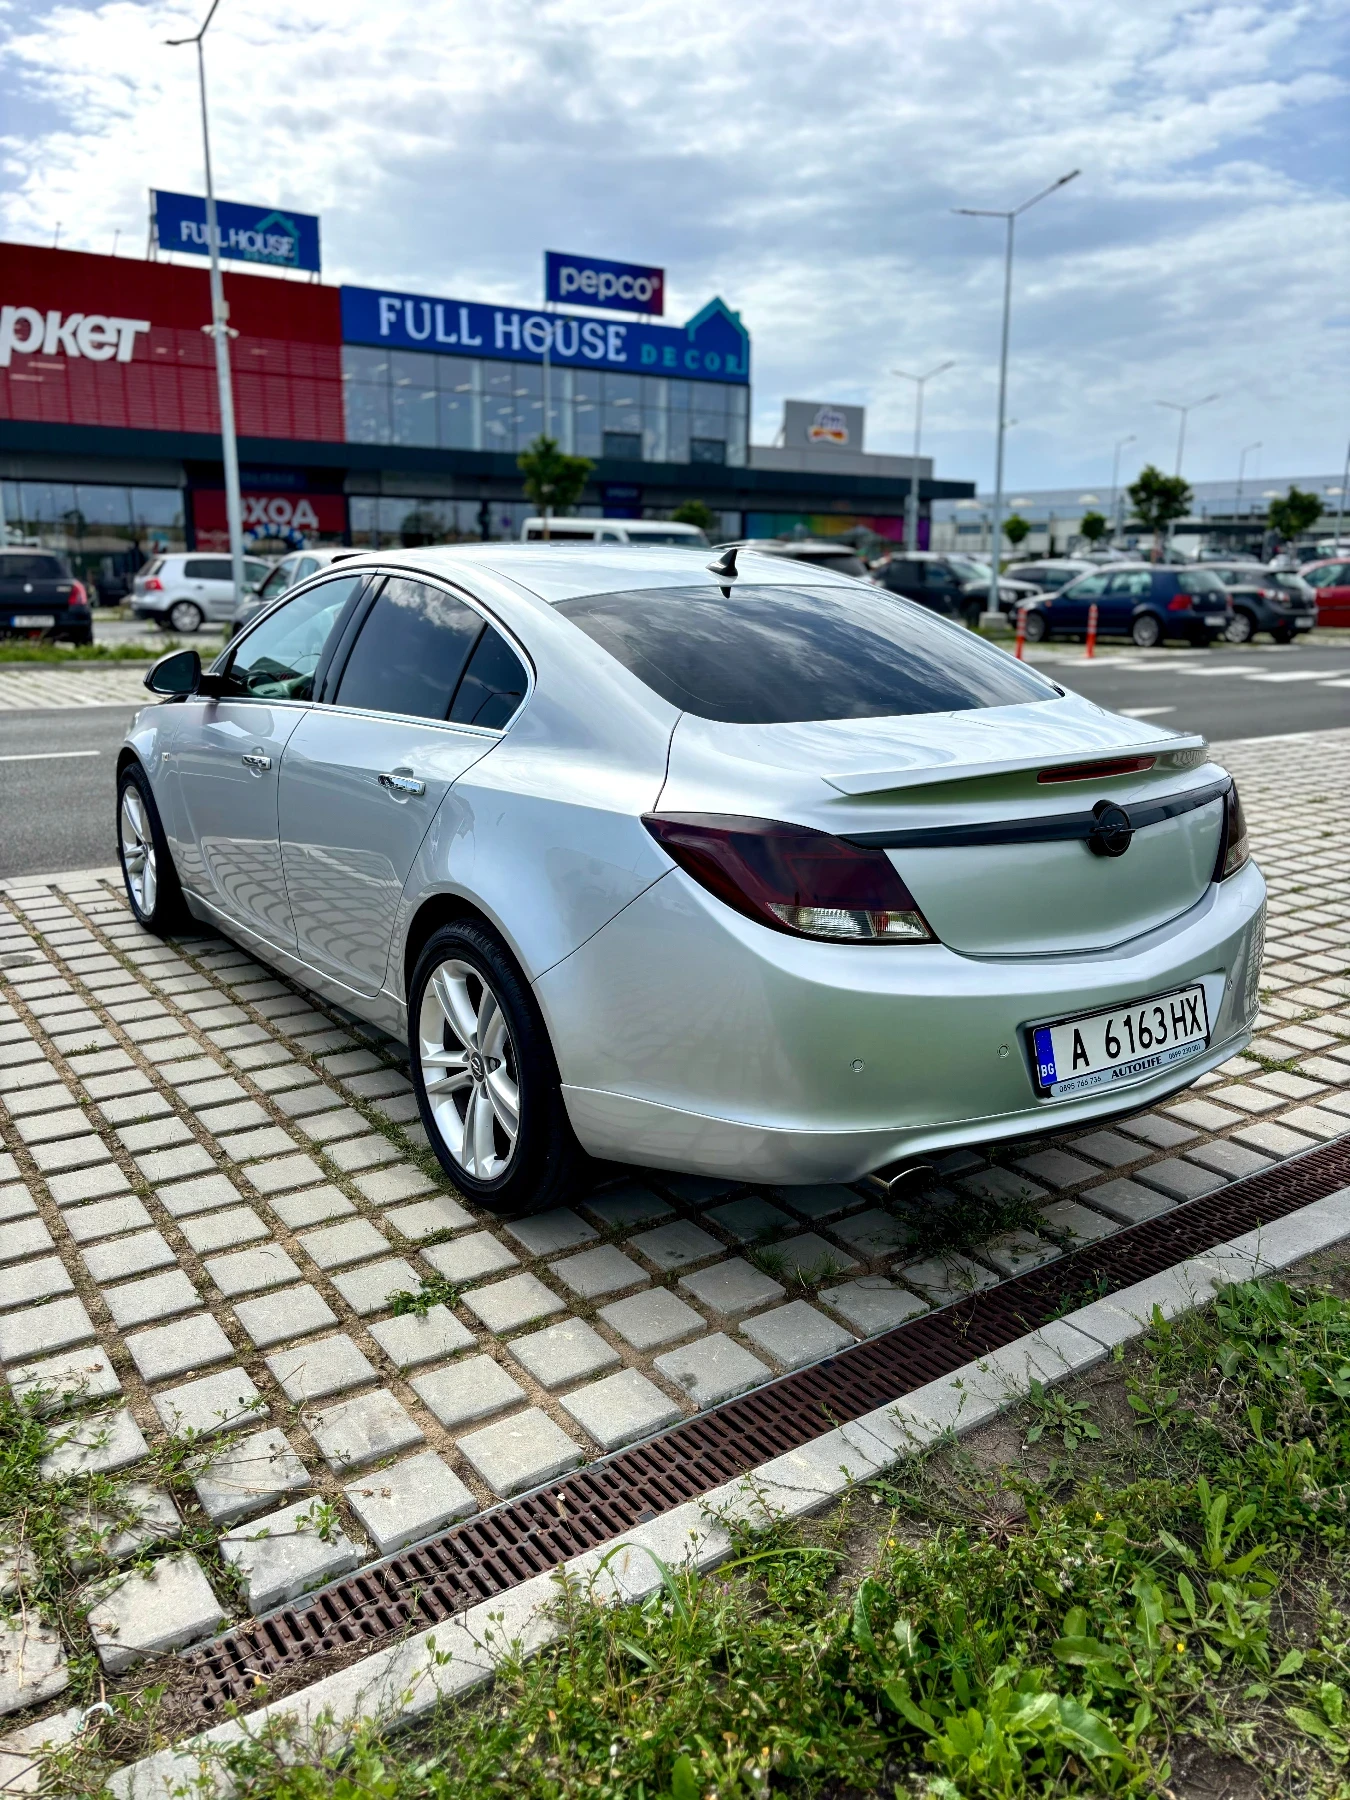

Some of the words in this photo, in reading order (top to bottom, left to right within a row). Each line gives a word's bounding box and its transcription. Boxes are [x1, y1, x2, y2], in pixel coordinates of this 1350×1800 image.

[229, 227, 295, 258] HOUSE
[378, 296, 482, 347] FULL
[494, 311, 627, 362] HOUSE
[640, 343, 744, 375] DECOR
[1072, 1028, 1090, 1070] A
[1040, 1064, 1055, 1077] BG
[1111, 1055, 1162, 1079] AUTOLIFE
